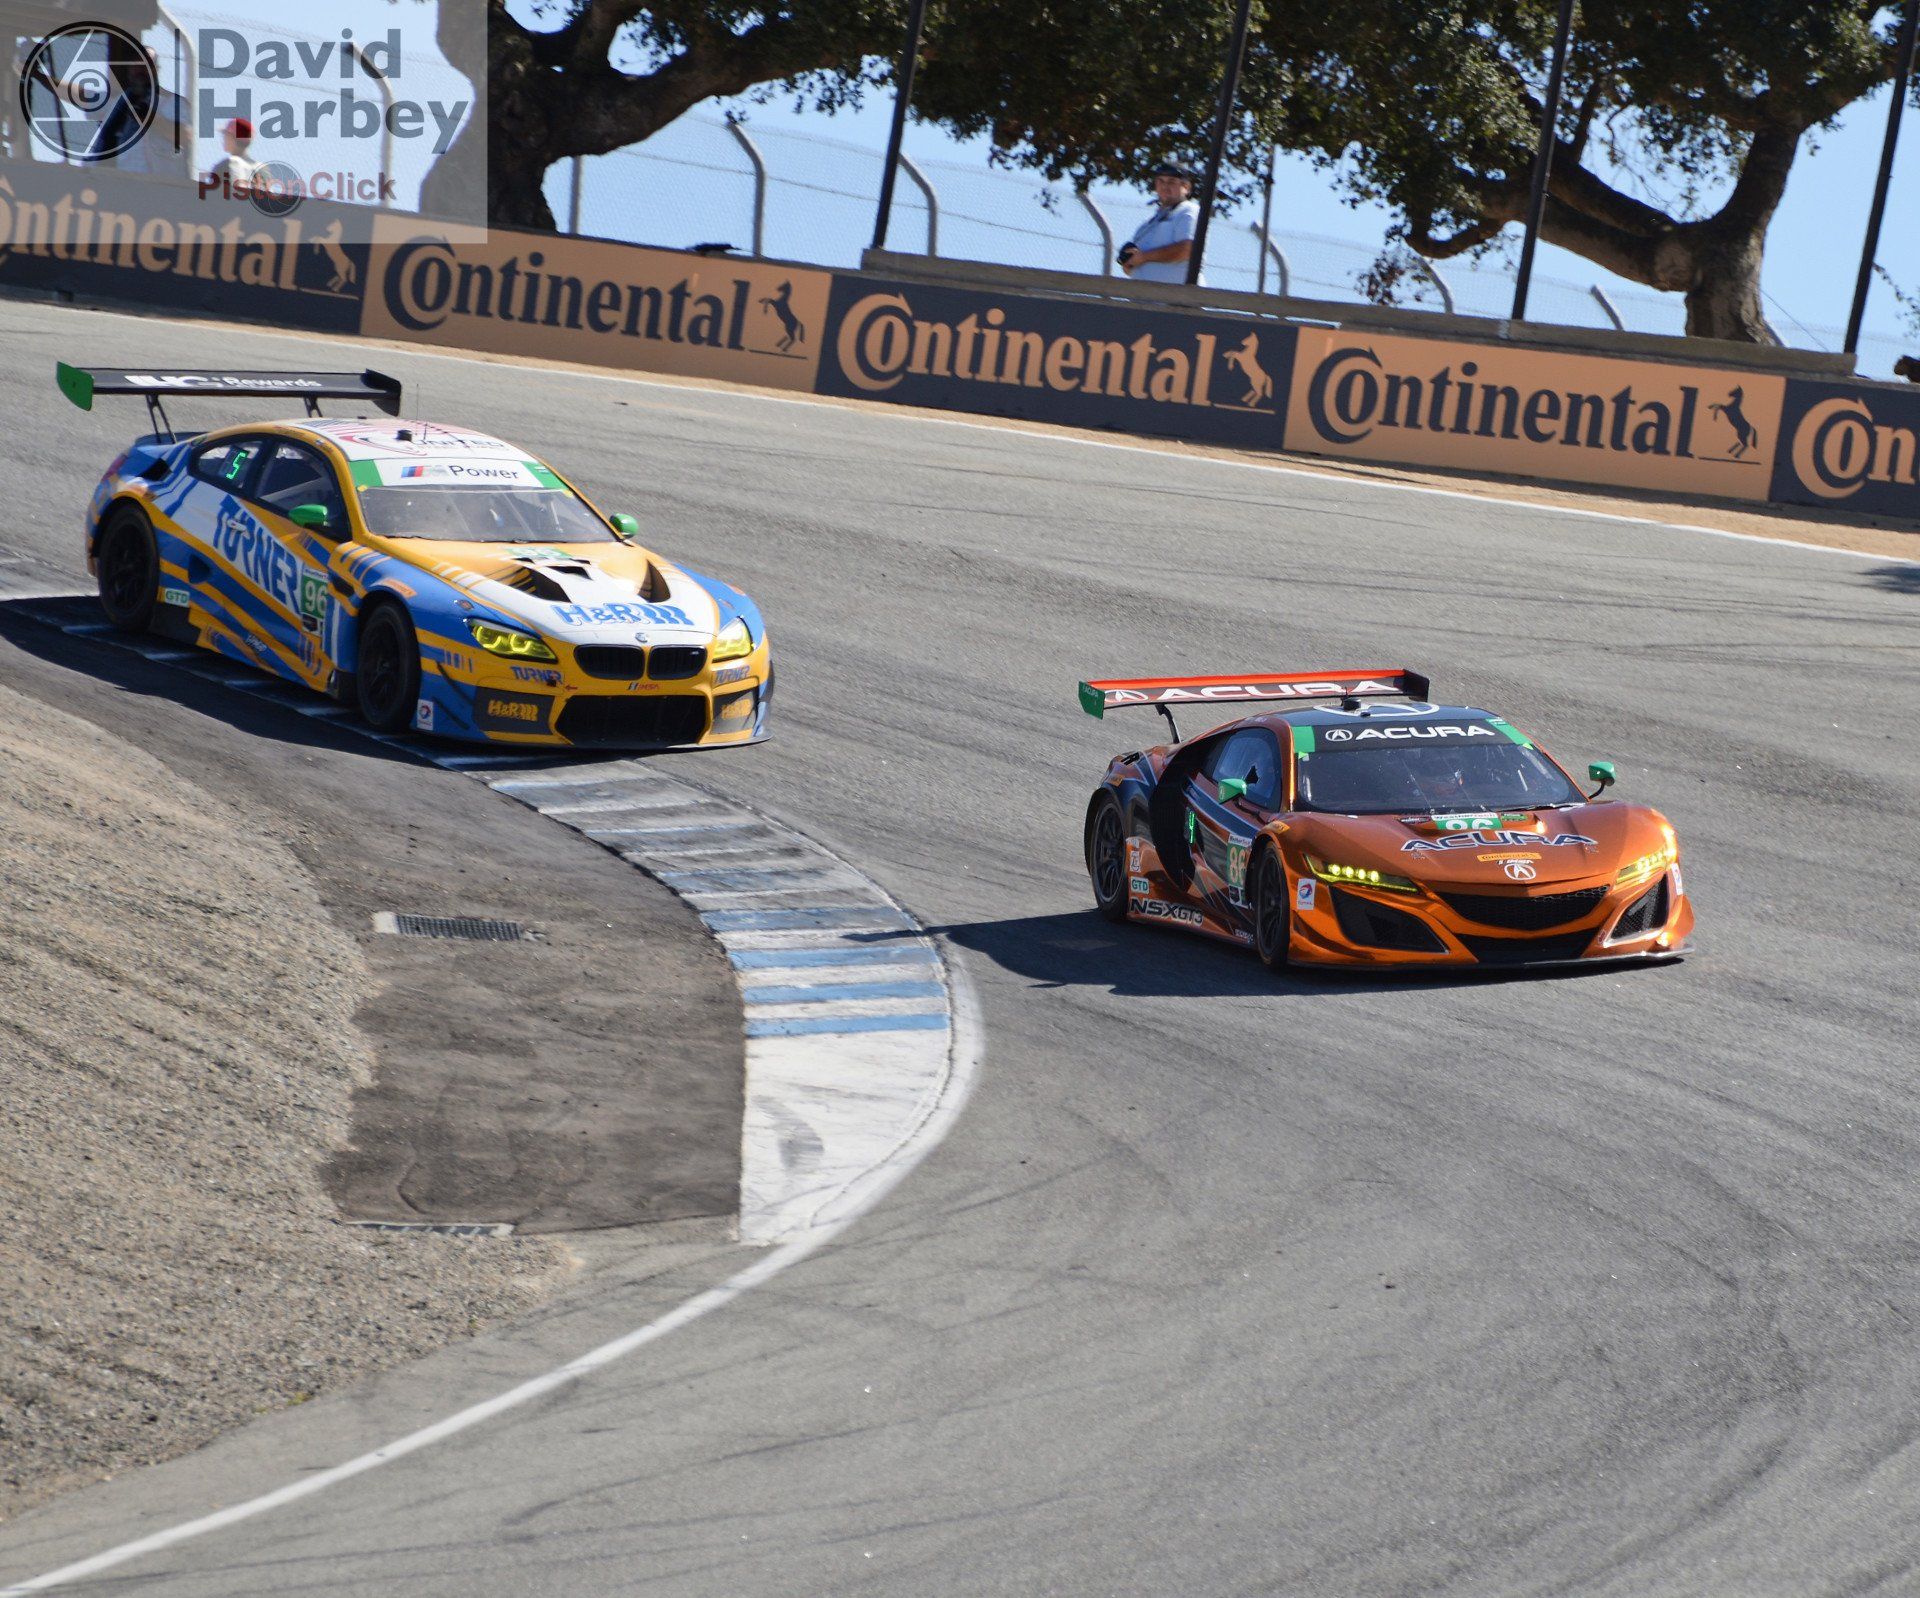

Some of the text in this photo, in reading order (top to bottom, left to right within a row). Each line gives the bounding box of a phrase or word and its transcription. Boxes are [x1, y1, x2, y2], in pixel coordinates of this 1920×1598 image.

[0, 174, 303, 291] ntinental
[383, 234, 744, 352] Continental
[836, 292, 1216, 407] Continental
[1307, 345, 1699, 459] Continental
[449, 464, 520, 480] Power
[212, 493, 301, 616] TURNER
[165, 590, 189, 604] GTD
[304, 580, 329, 618] 96
[510, 665, 564, 685] TURNER
[1157, 680, 1400, 701] ACURA
[1355, 725, 1496, 741] ACURA
[1400, 830, 1600, 852] ACURA
[1131, 880, 1149, 893] GTD
